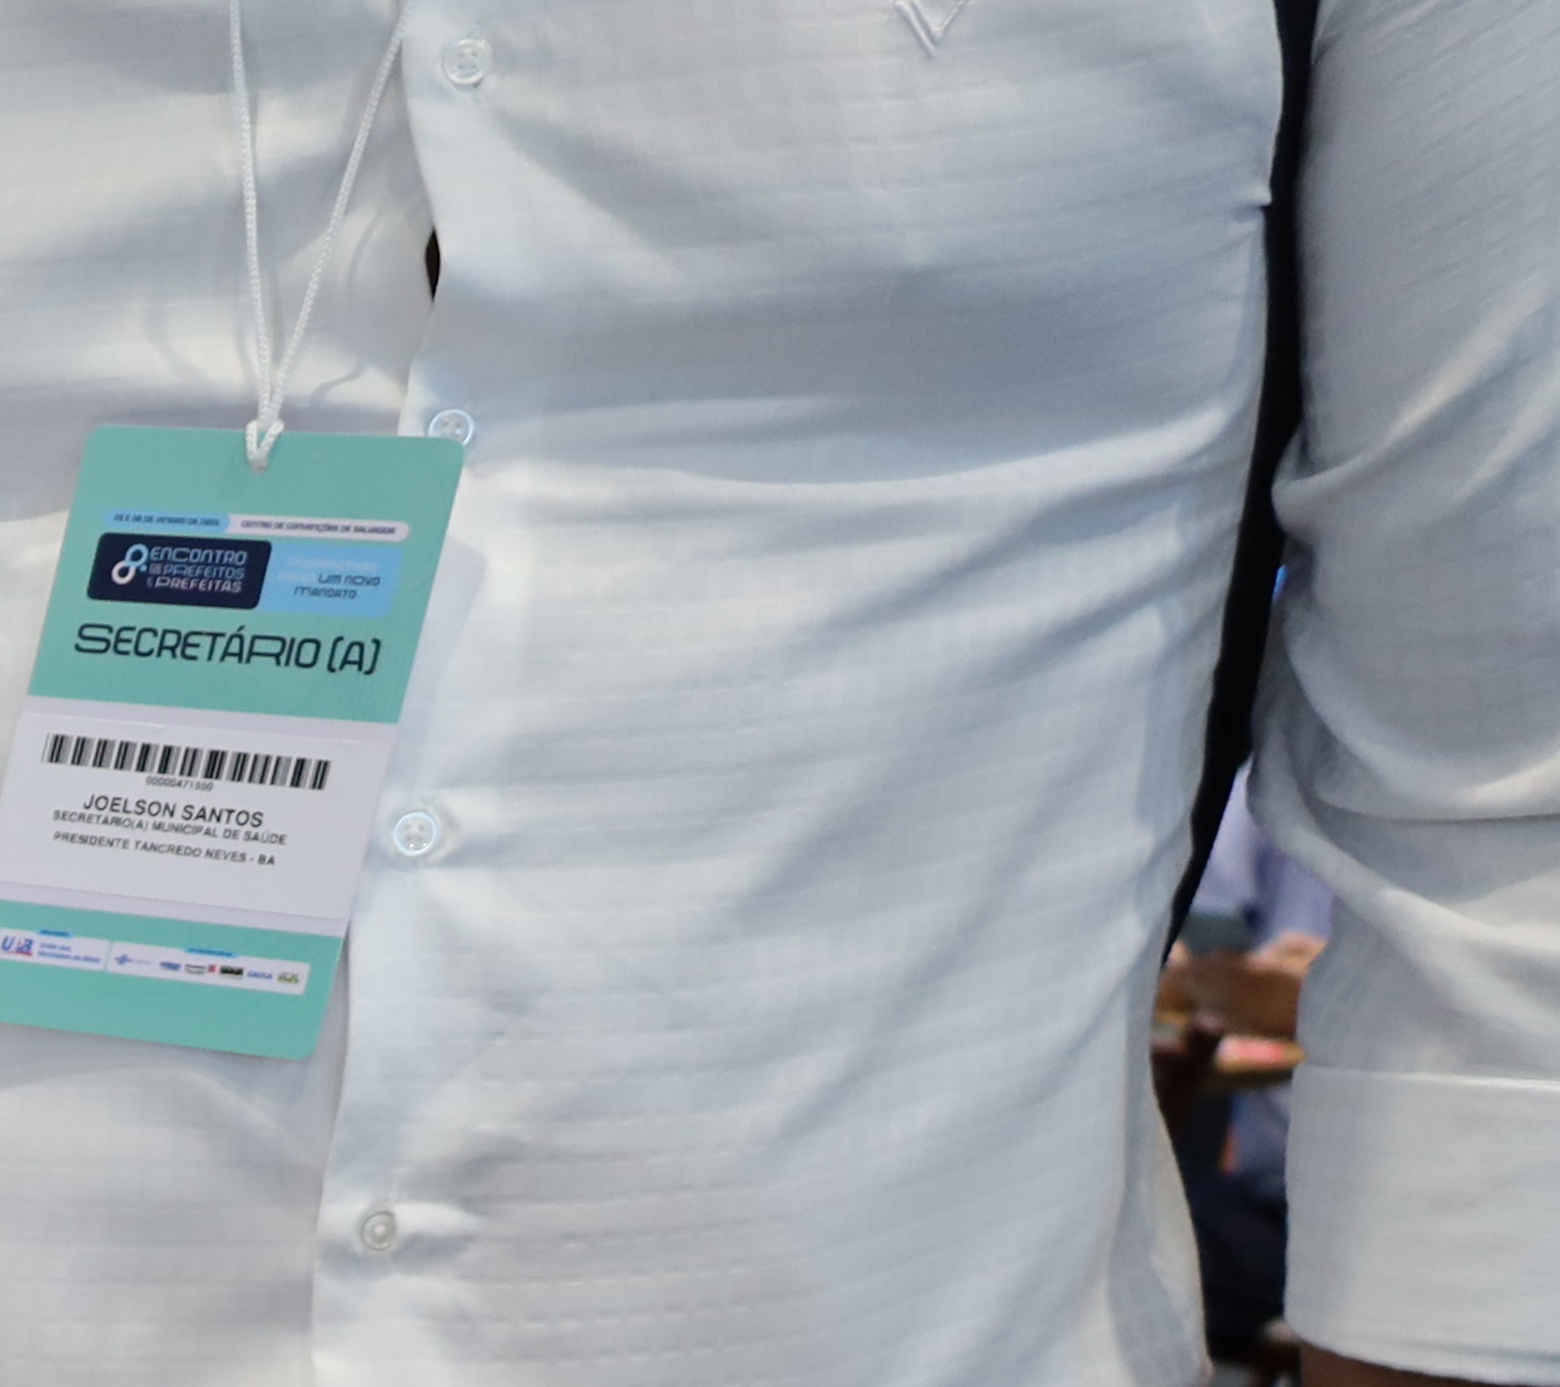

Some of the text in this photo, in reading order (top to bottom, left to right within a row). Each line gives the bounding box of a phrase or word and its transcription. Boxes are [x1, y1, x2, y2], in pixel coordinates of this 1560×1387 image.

[150, 546, 247, 565] ENCONTRO
[163, 563, 245, 579] PREFEITOS
[155, 577, 242, 593] PREFEITAS
[74, 623, 381, 676] SECRETÁRIO (A)
[83, 794, 264, 828] JOELSON SANTOS
[152, 821, 218, 839] MUNICIPAL
[223, 829, 239, 840] DE
[53, 831, 130, 849] PRESIDENTE
[134, 839, 202, 858] TANCREDO
[205, 848, 247, 863] NEVES
[257, 855, 275, 866] BA
